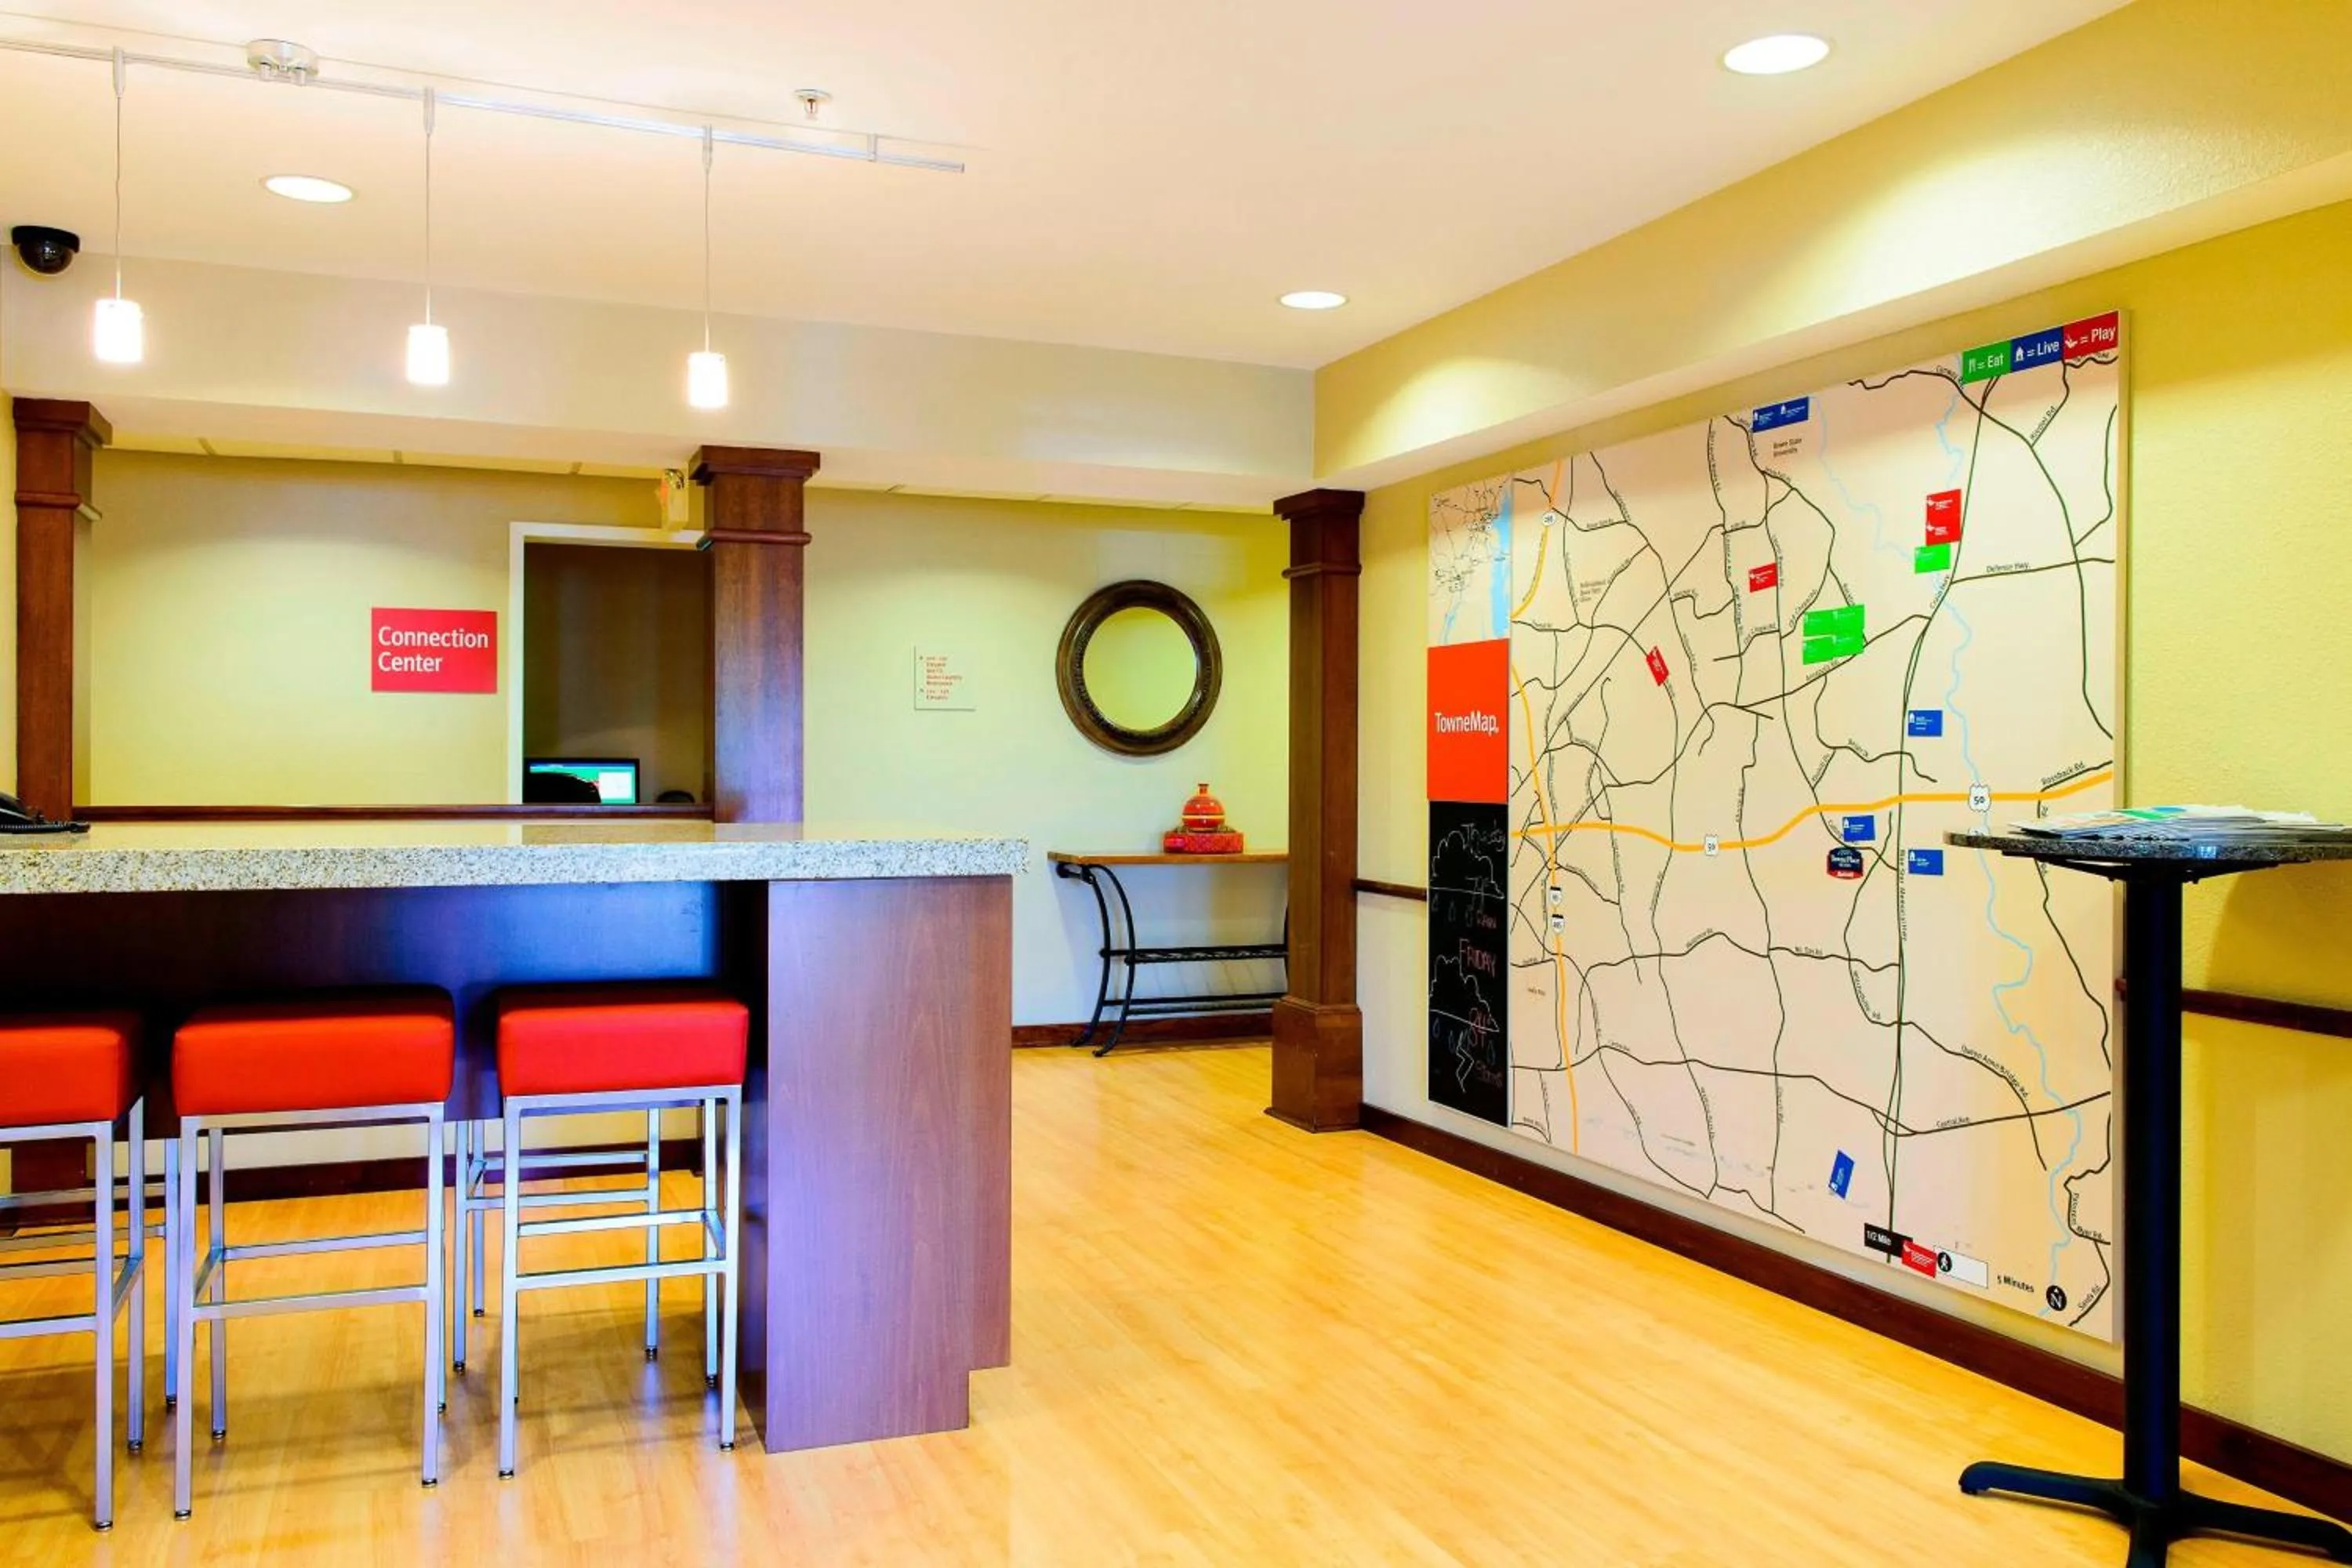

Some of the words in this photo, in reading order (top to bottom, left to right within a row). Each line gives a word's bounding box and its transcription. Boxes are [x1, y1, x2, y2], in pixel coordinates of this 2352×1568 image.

[2091, 326, 2116, 343] Play
[2038, 340, 2060, 356] Live
[1987, 353, 2004, 368] Eat
[378, 626, 489, 648] Connection
[378, 652, 443, 672] Center
[1974, 796, 1986, 805] 50
[1997, 1275, 2002, 1285] 5
[2003, 1275, 2034, 1293] Minutes
